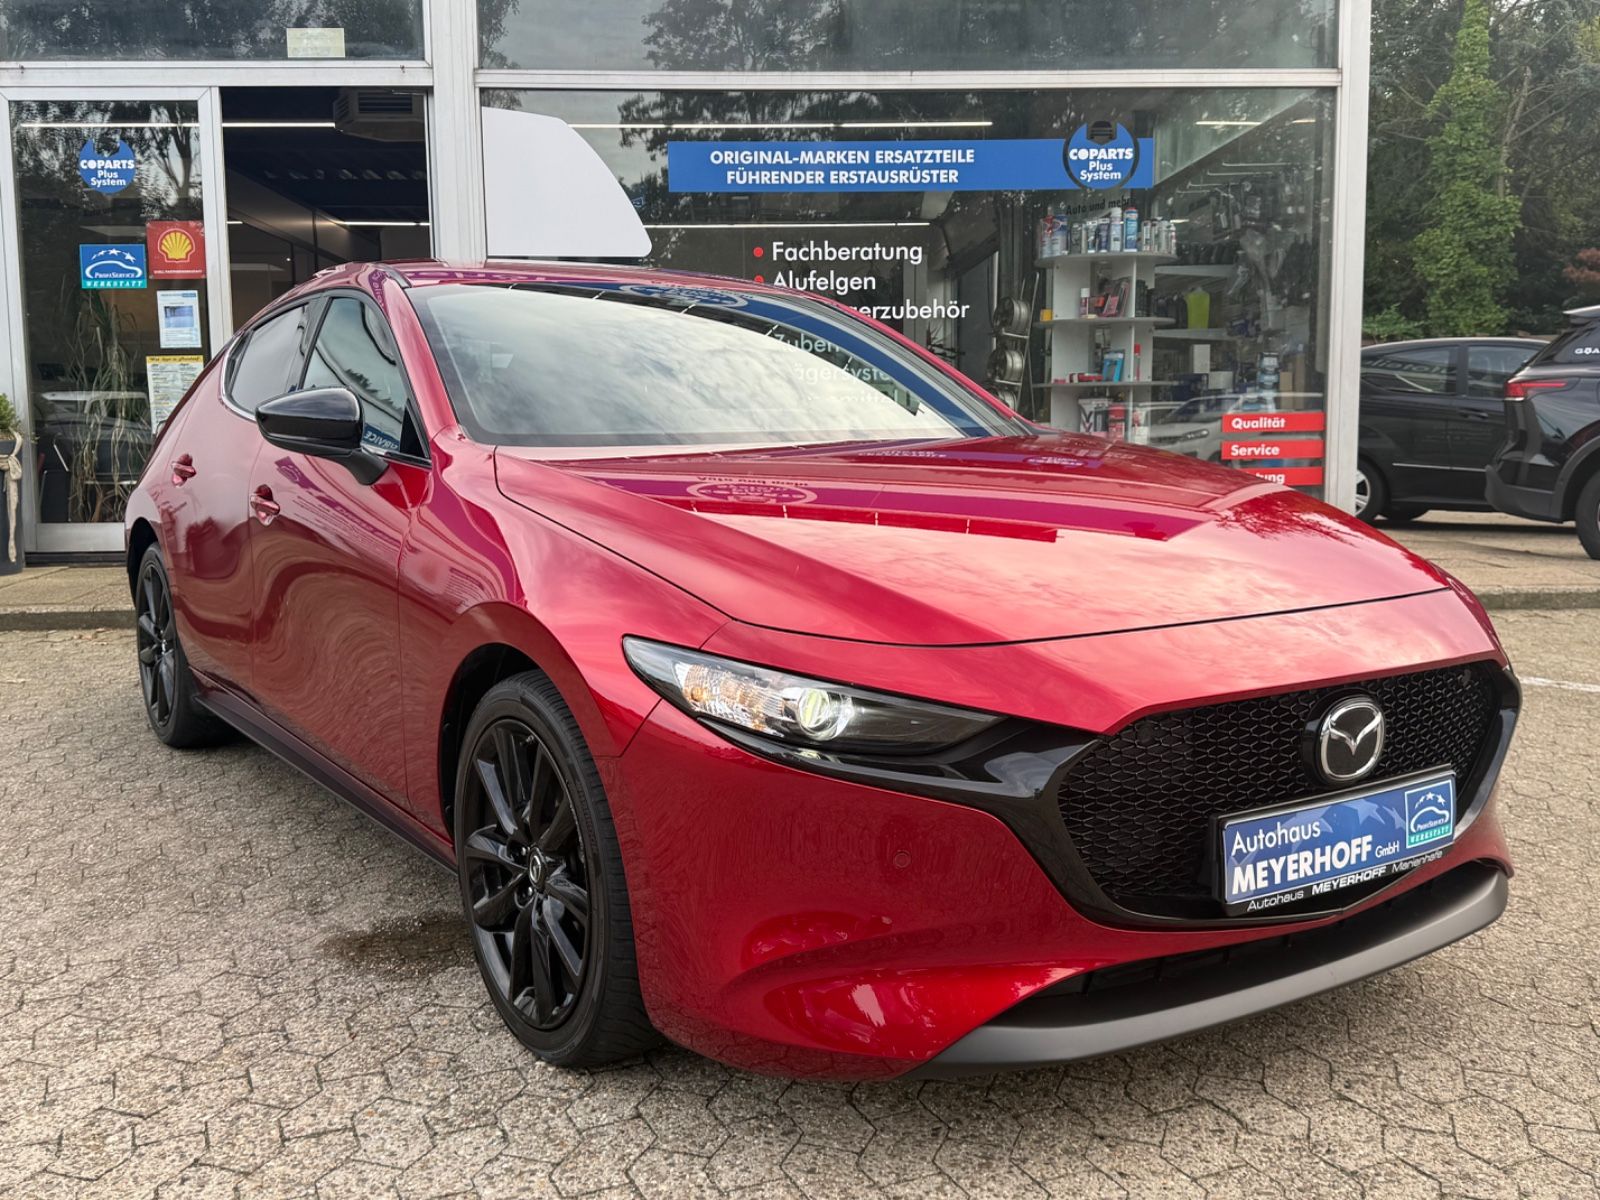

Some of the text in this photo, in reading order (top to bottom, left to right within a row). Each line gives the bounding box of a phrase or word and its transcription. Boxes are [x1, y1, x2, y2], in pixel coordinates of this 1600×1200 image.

[709, 148, 976, 166] ORIGINAL-MARKEN ERSATZTEILE
[1069, 148, 1134, 160] COPARTS
[79, 159, 135, 170] COPARTS
[1088, 160, 1113, 171] Plus
[97, 169, 119, 179] Plus
[726, 166, 960, 186] FÜHRENDER ERSTAUSRÜSTER
[1080, 170, 1121, 182] System
[90, 176, 126, 188] System
[772, 240, 923, 265] Fachberatung
[773, 269, 876, 296] Alufelgen
[1231, 417, 1286, 430] Qualität
[1231, 444, 1280, 456] Service
[1231, 821, 1321, 856] Autohaus
[1232, 835, 1400, 895] MEYERHOFF GmbH
[1247, 889, 1304, 912] Autohaus
[1311, 866, 1387, 895] MEYERHOFF
